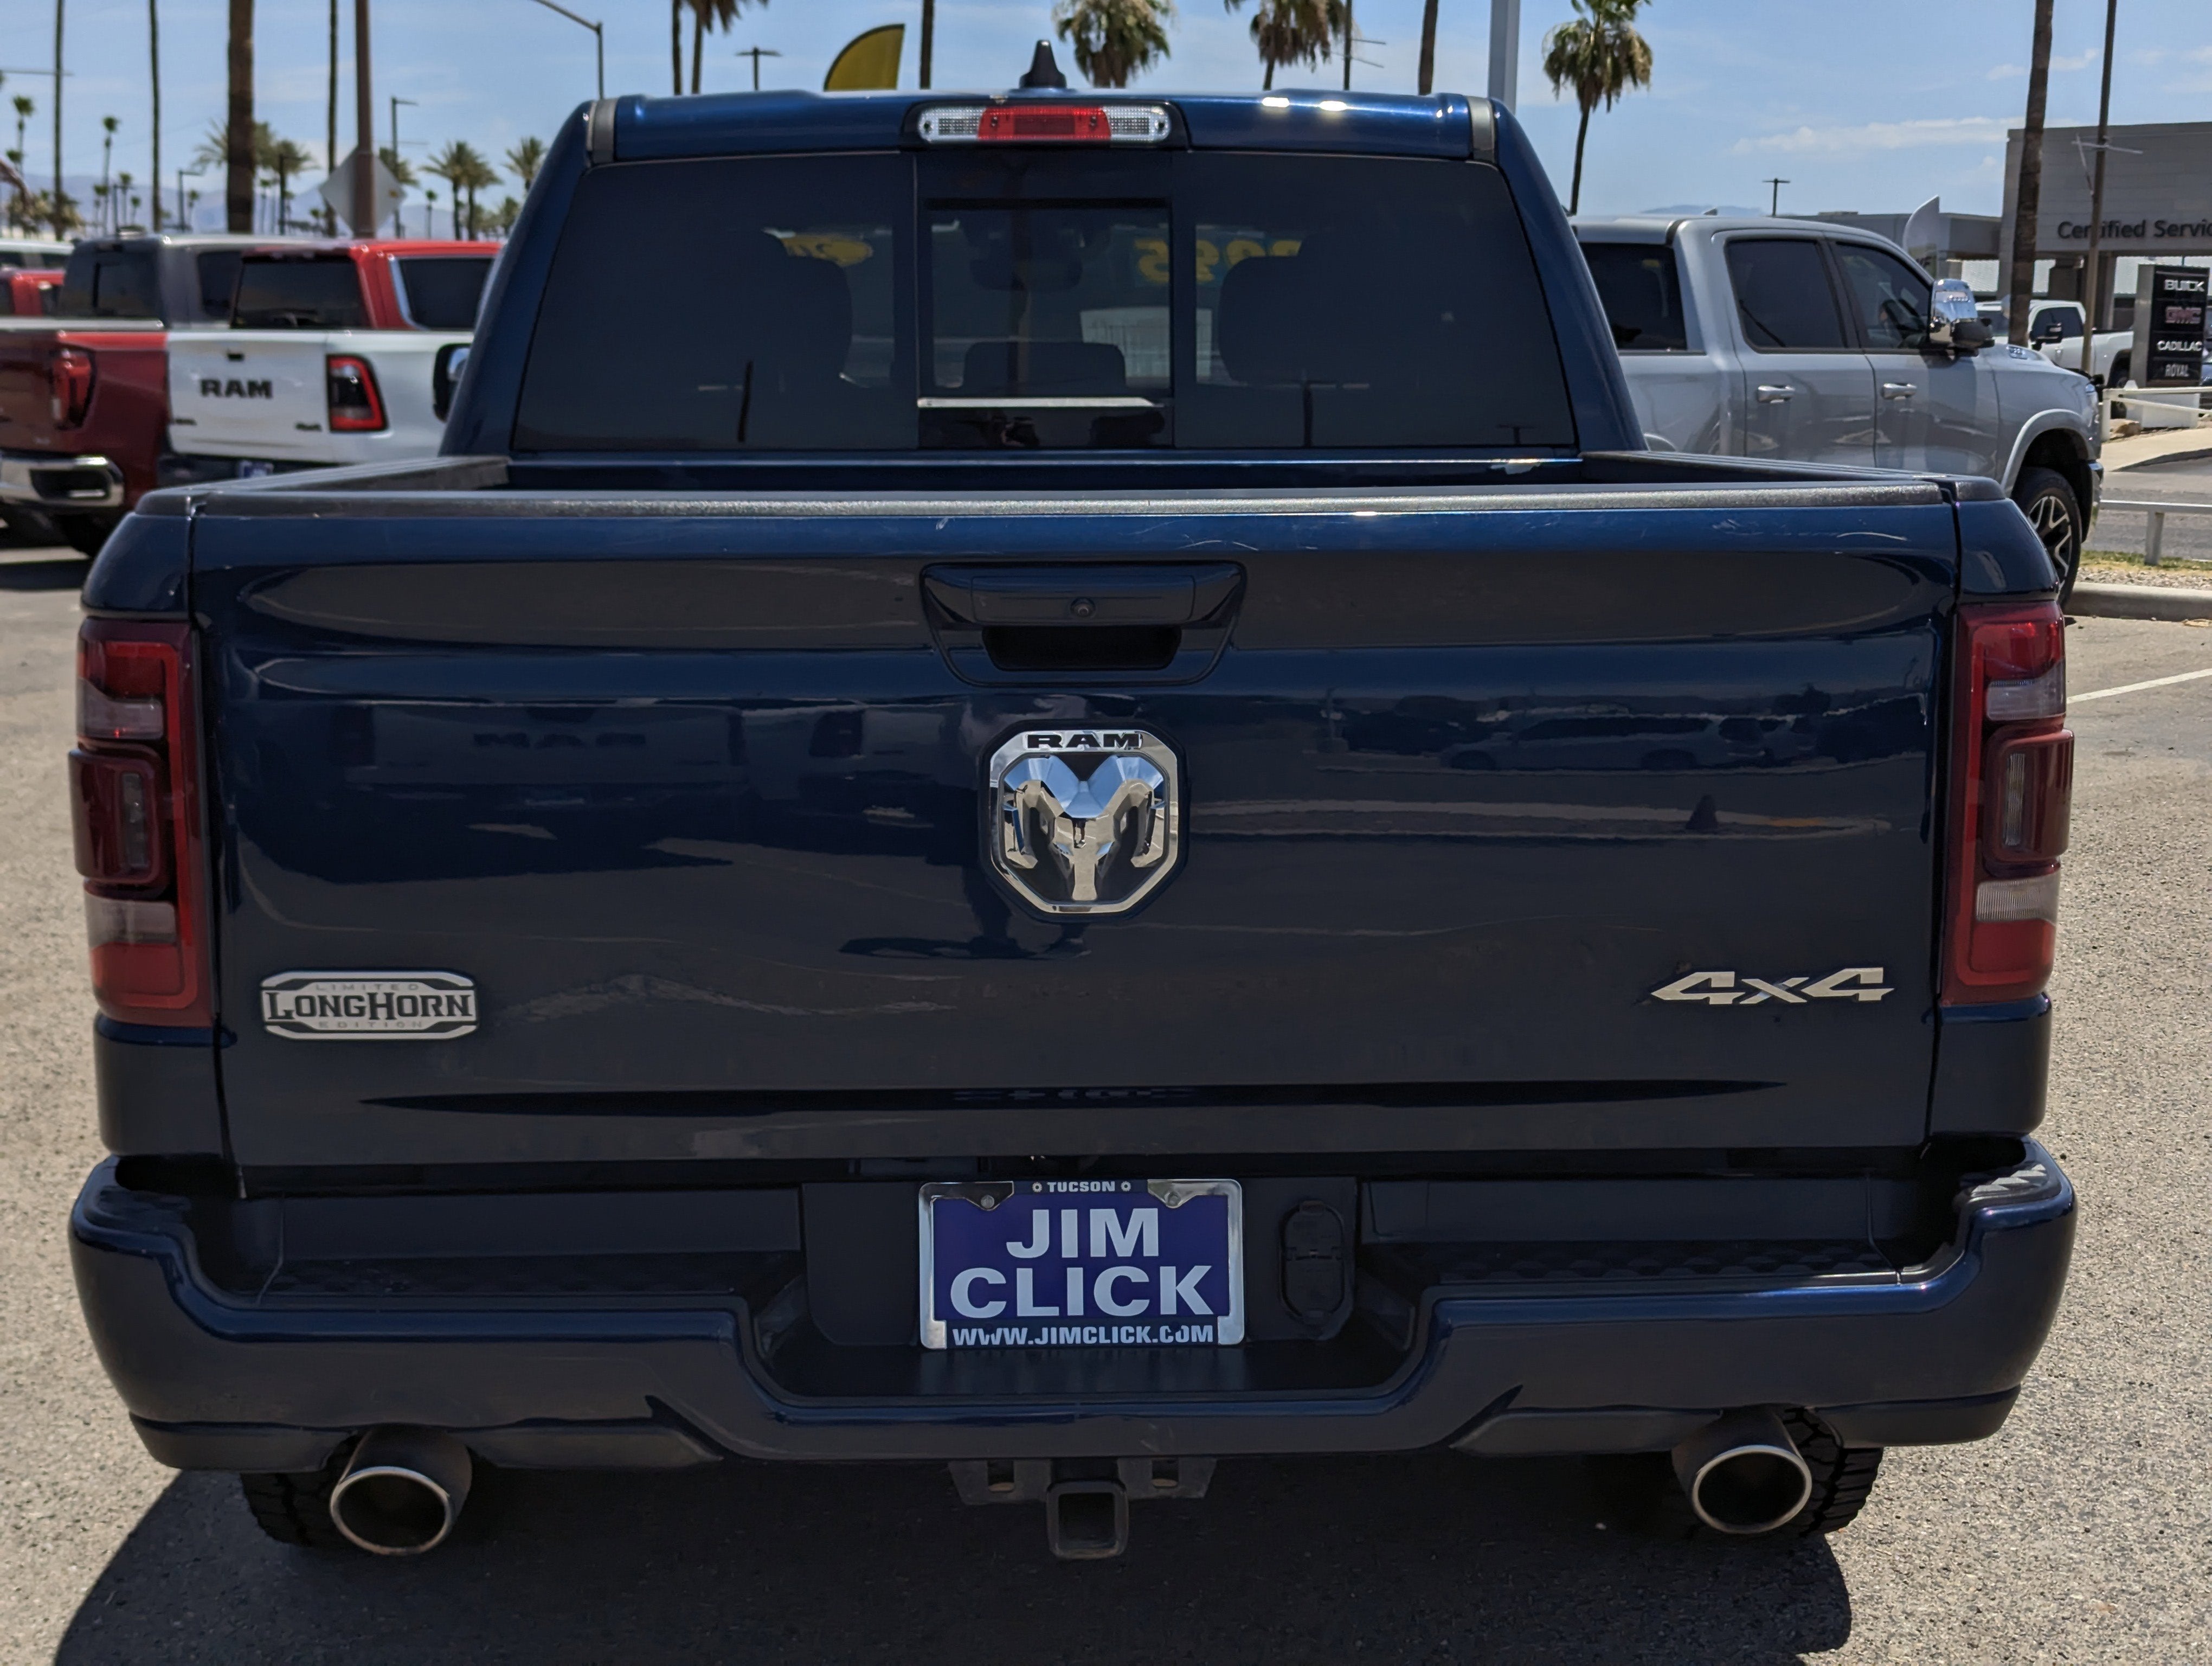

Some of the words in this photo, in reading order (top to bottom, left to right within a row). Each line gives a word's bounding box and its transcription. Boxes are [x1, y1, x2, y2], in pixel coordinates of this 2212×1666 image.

[2058, 219, 2146, 239] Cerified
[2164, 279, 2204, 292] BUICK
[2165, 306, 2202, 324] GMC
[2157, 340, 2202, 351] CADILLAC
[200, 379, 273, 399] RAM
[1027, 733, 1140, 749] RAM
[316, 983, 420, 991] LIMITED
[318, 1021, 423, 1029] EDITION
[1047, 1181, 1115, 1193] TUCSON
[1006, 1208, 1159, 1259] JIM
[950, 1265, 1214, 1319] CLICK
[952, 1325, 1214, 1346] WWW.JIMCLICK.COM
